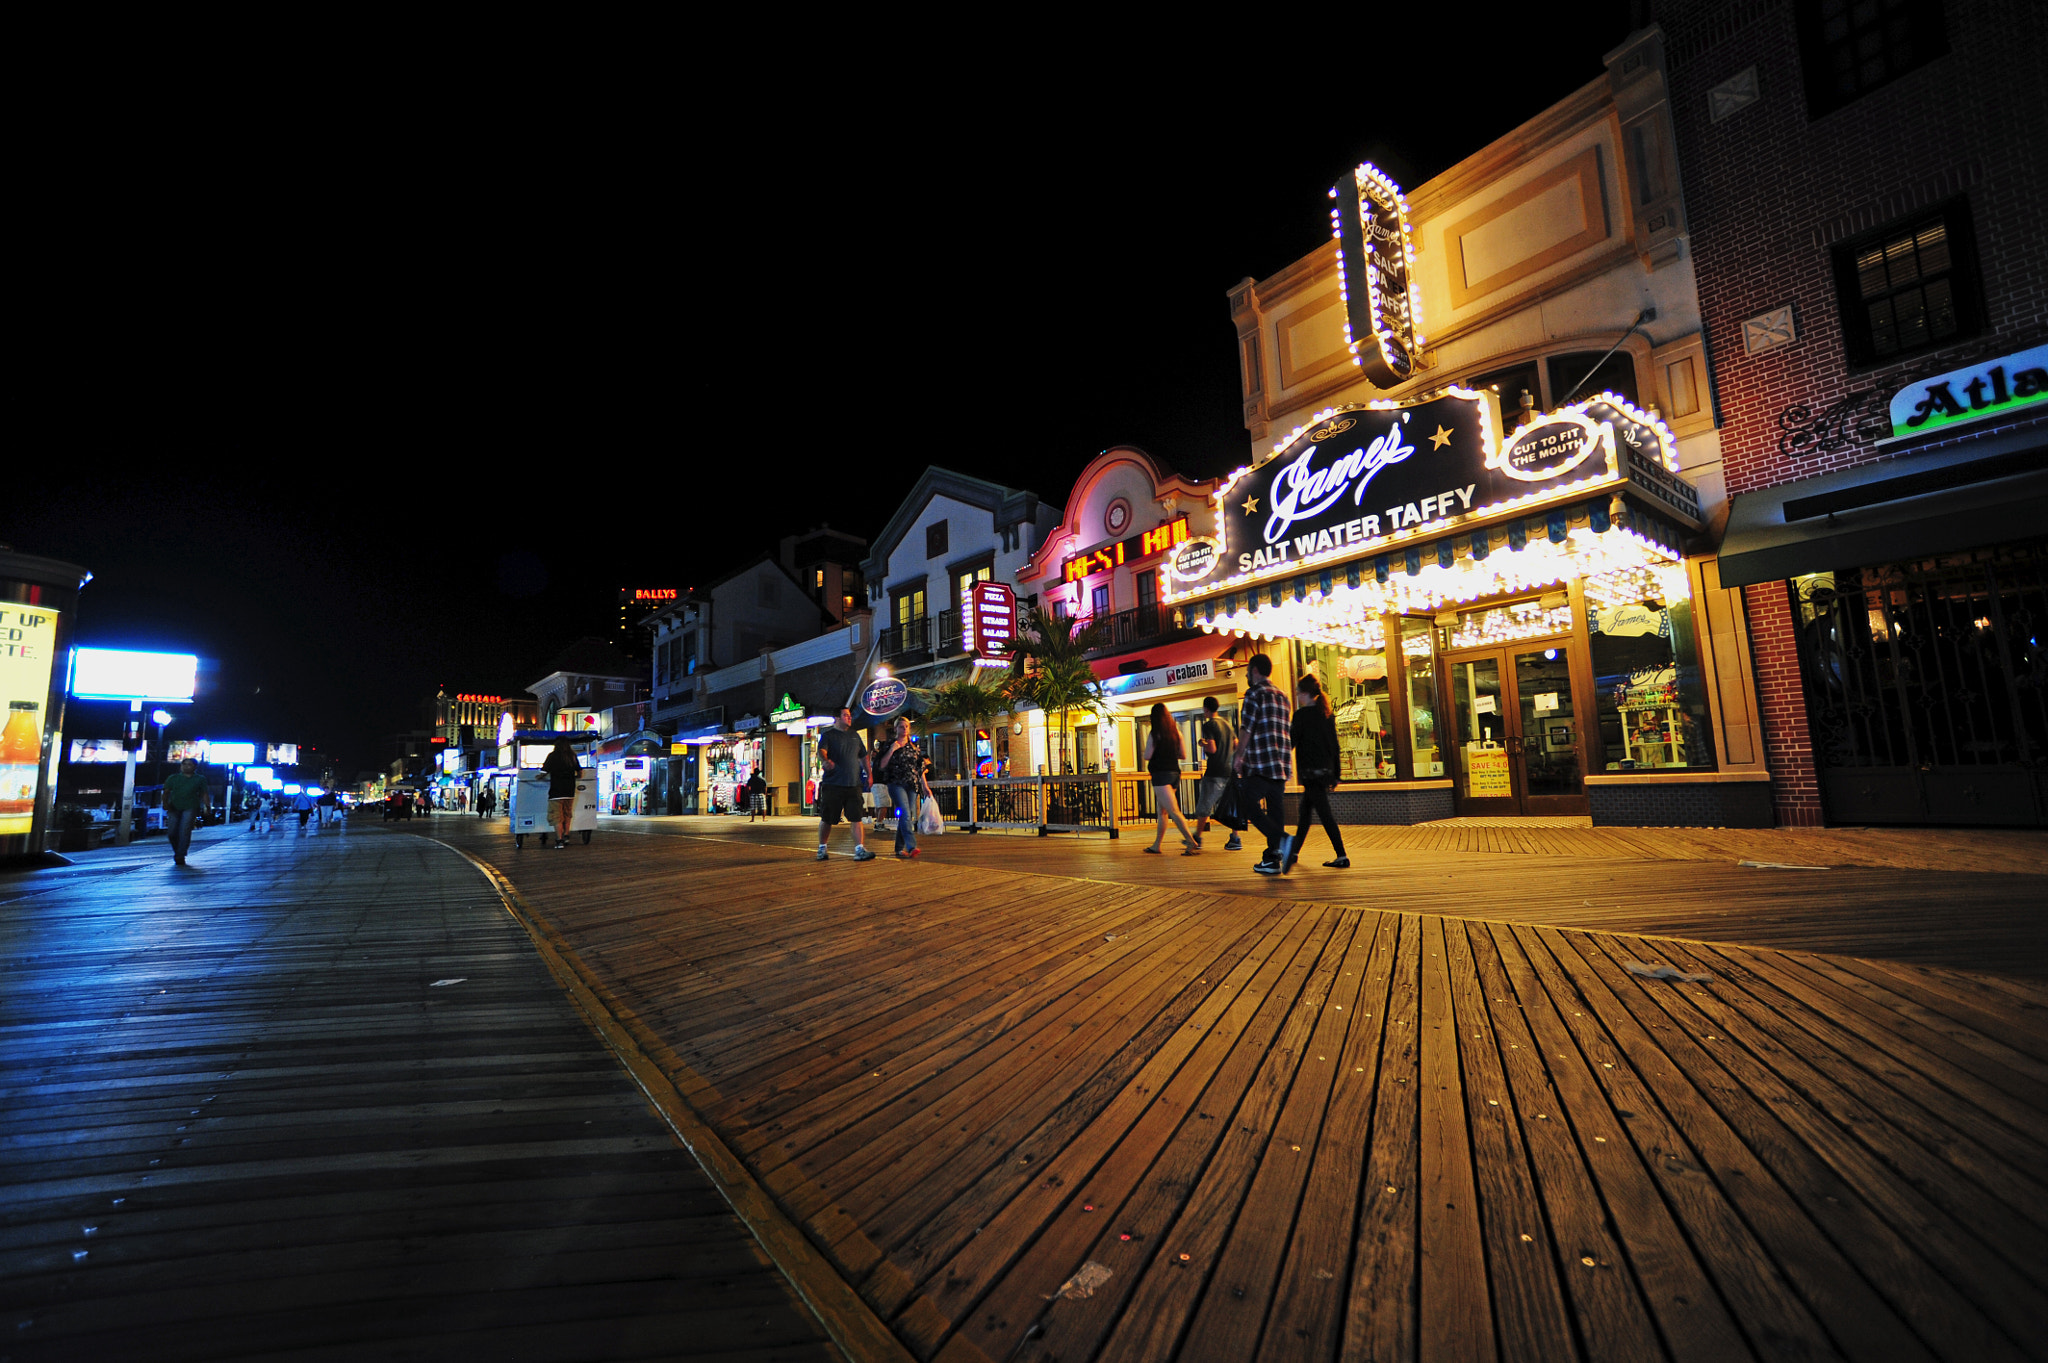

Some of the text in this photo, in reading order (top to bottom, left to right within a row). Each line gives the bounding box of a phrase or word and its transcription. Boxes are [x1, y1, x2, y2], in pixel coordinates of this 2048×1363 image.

[1373, 250, 1399, 277] SALT
[1513, 427, 1580, 456] CUT TO FIT
[1512, 438, 1585, 467] THE MOUTH
[1239, 484, 1475, 573] SALT WATER TAFFY
[1178, 546, 1212, 563] CUT TO FIT
[635, 589, 677, 600] BALLYS
[984, 592, 1005, 602] PIZZA
[19, 613, 46, 628] UP
[982, 616, 1009, 626] STEAKS
[1607, 610, 1651, 633] James
[982, 628, 1009, 638] SALADS
[0, 643, 37, 660] TE.
[1175, 663, 1208, 681] cabana
[456, 693, 502, 704] CAESARS
[1471, 761, 1491, 770] SAVE
